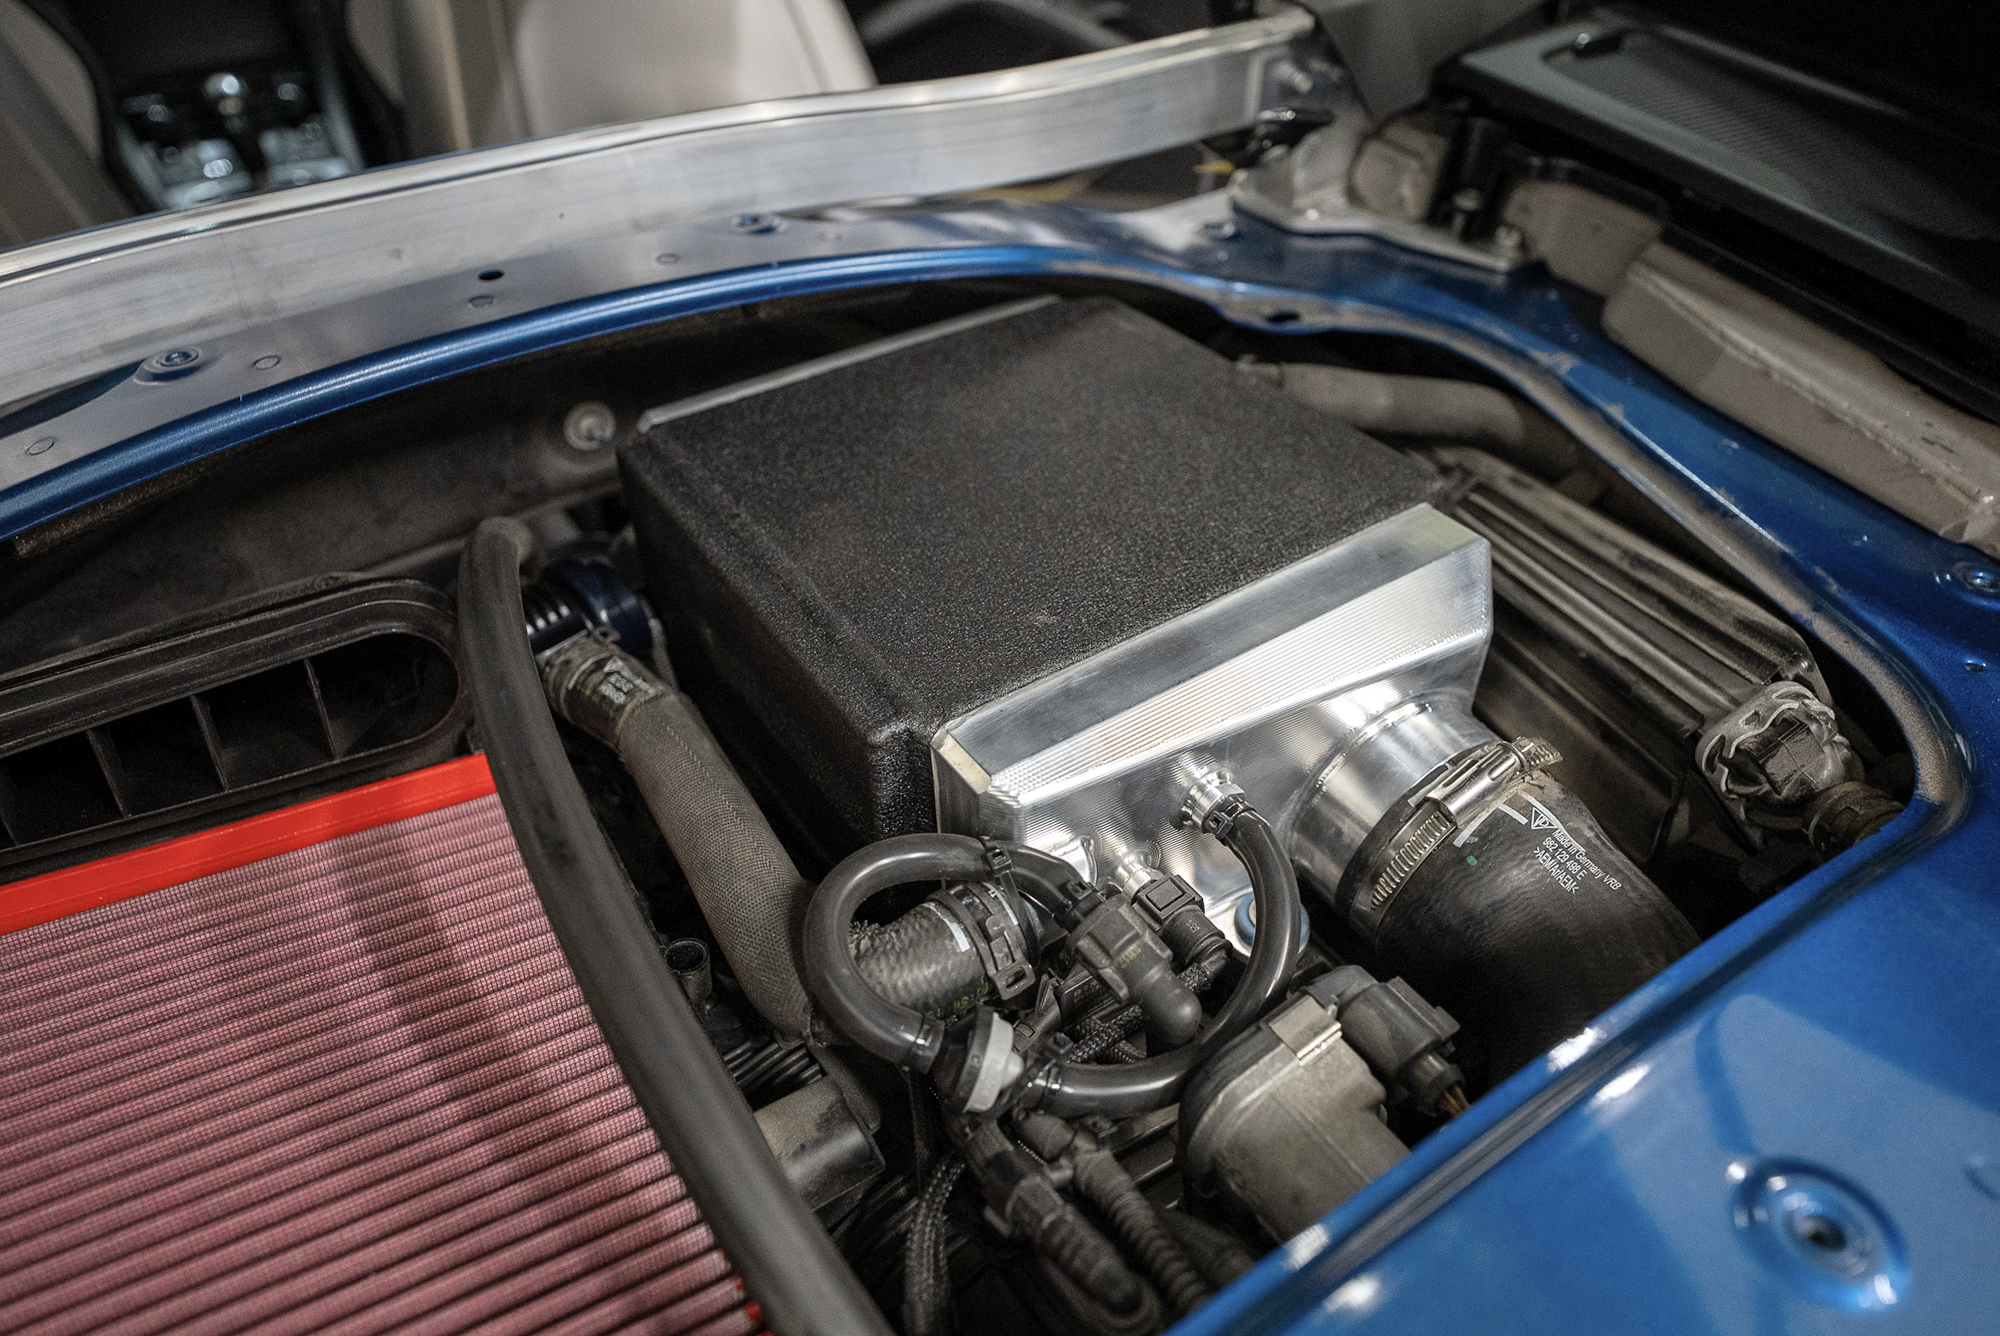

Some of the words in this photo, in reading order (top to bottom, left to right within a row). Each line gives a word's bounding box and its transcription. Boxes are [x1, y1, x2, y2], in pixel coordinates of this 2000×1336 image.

[1542, 836, 1558, 852] 982
[1554, 848, 1569, 863] 129
[1565, 859, 1580, 874] 498
[1576, 869, 1587, 880] E
[1552, 828, 1570, 848] Made
[1569, 843, 1577, 855] in
[1575, 850, 1605, 879] Germany
[1603, 874, 1622, 890] VRB
